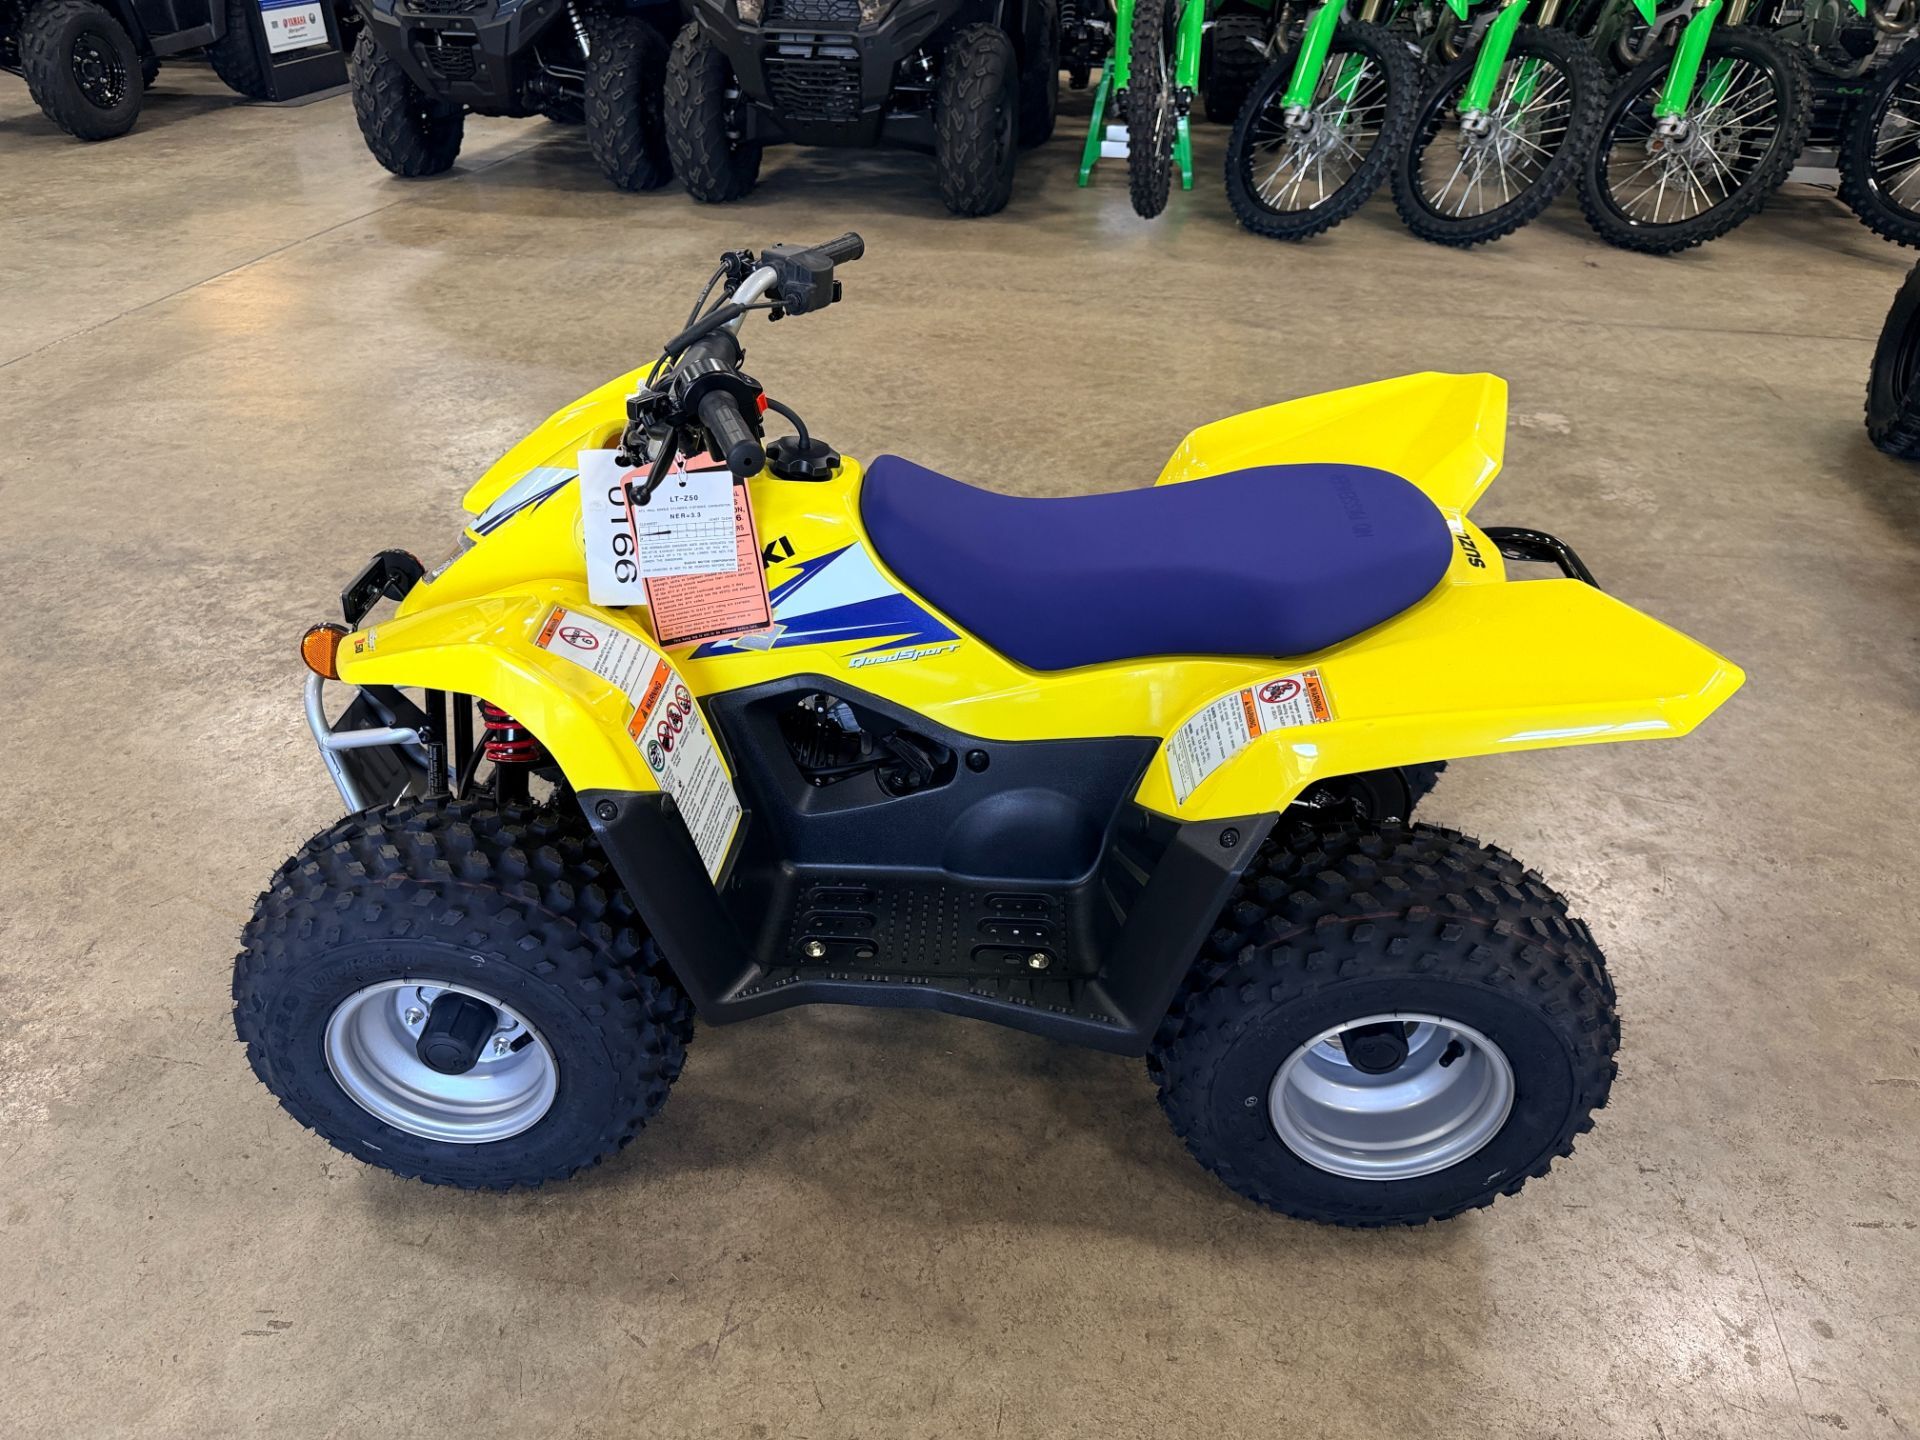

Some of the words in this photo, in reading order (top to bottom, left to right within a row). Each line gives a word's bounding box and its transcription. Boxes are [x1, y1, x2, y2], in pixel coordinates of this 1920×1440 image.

[669, 494, 699, 502] LT-Z50
[849, 645, 960, 668] QuadSport
[1312, 687, 1324, 713] WARNING
